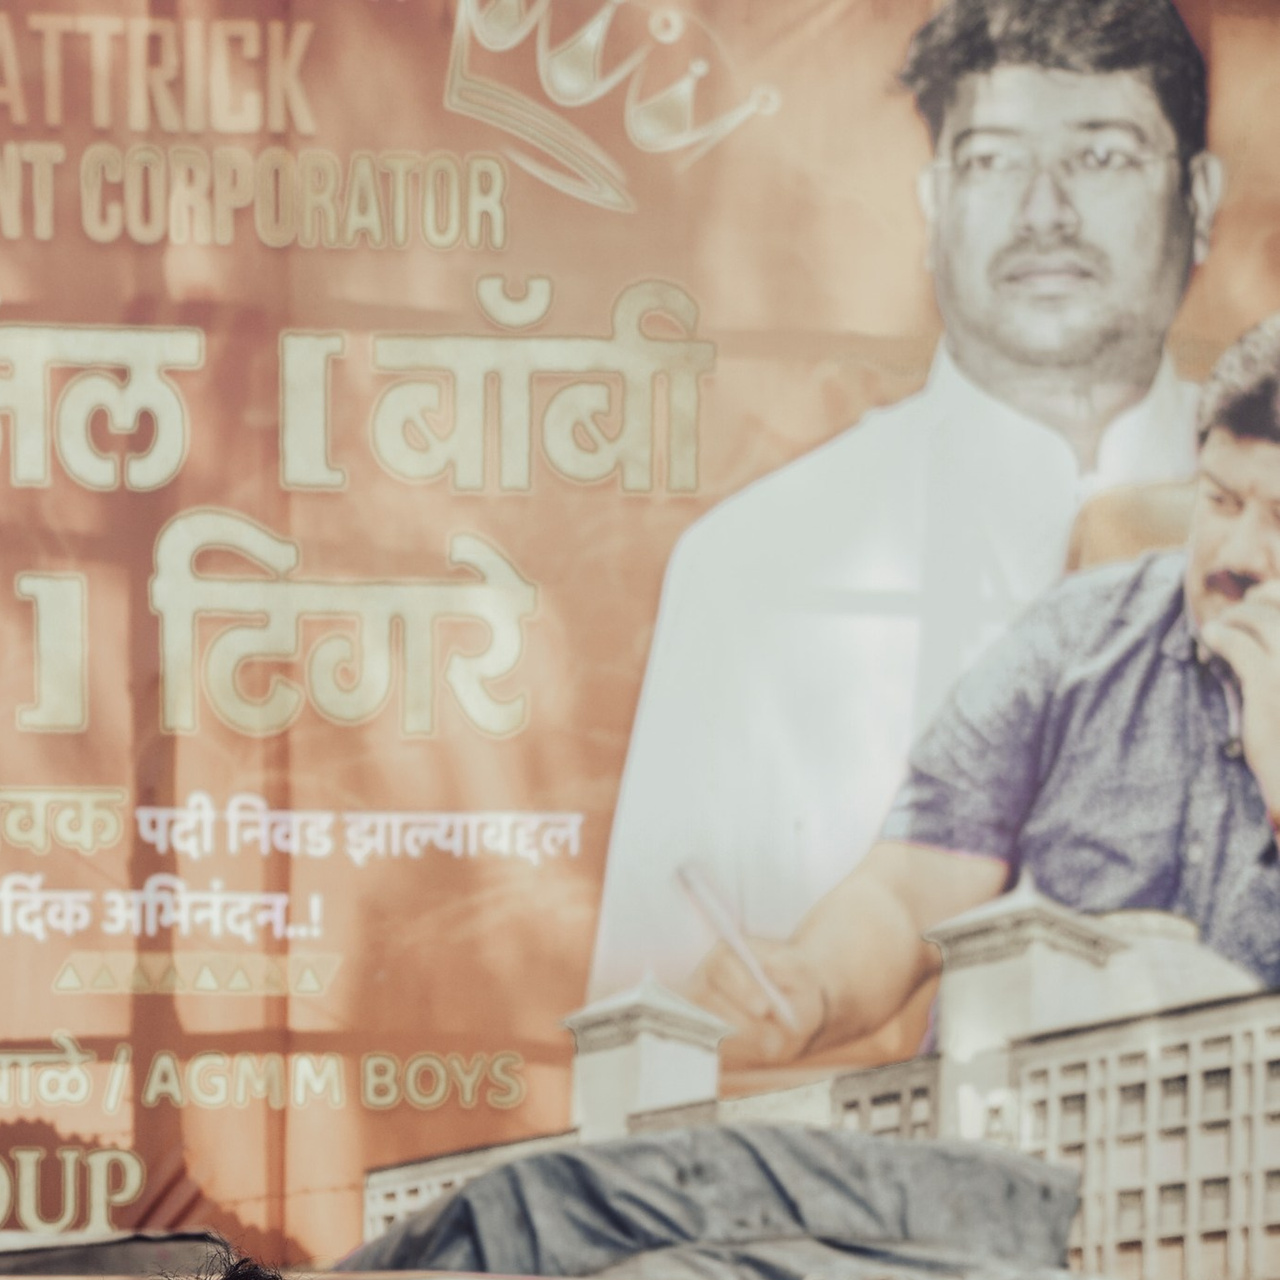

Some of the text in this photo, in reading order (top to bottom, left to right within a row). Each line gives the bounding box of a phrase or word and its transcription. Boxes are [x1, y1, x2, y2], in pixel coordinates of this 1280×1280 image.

[80, 142, 508, 250] CORPORATOR
[135, 790, 216, 861] पदी
[226, 792, 335, 858] निवड
[361, 1051, 528, 1111] BOYS
